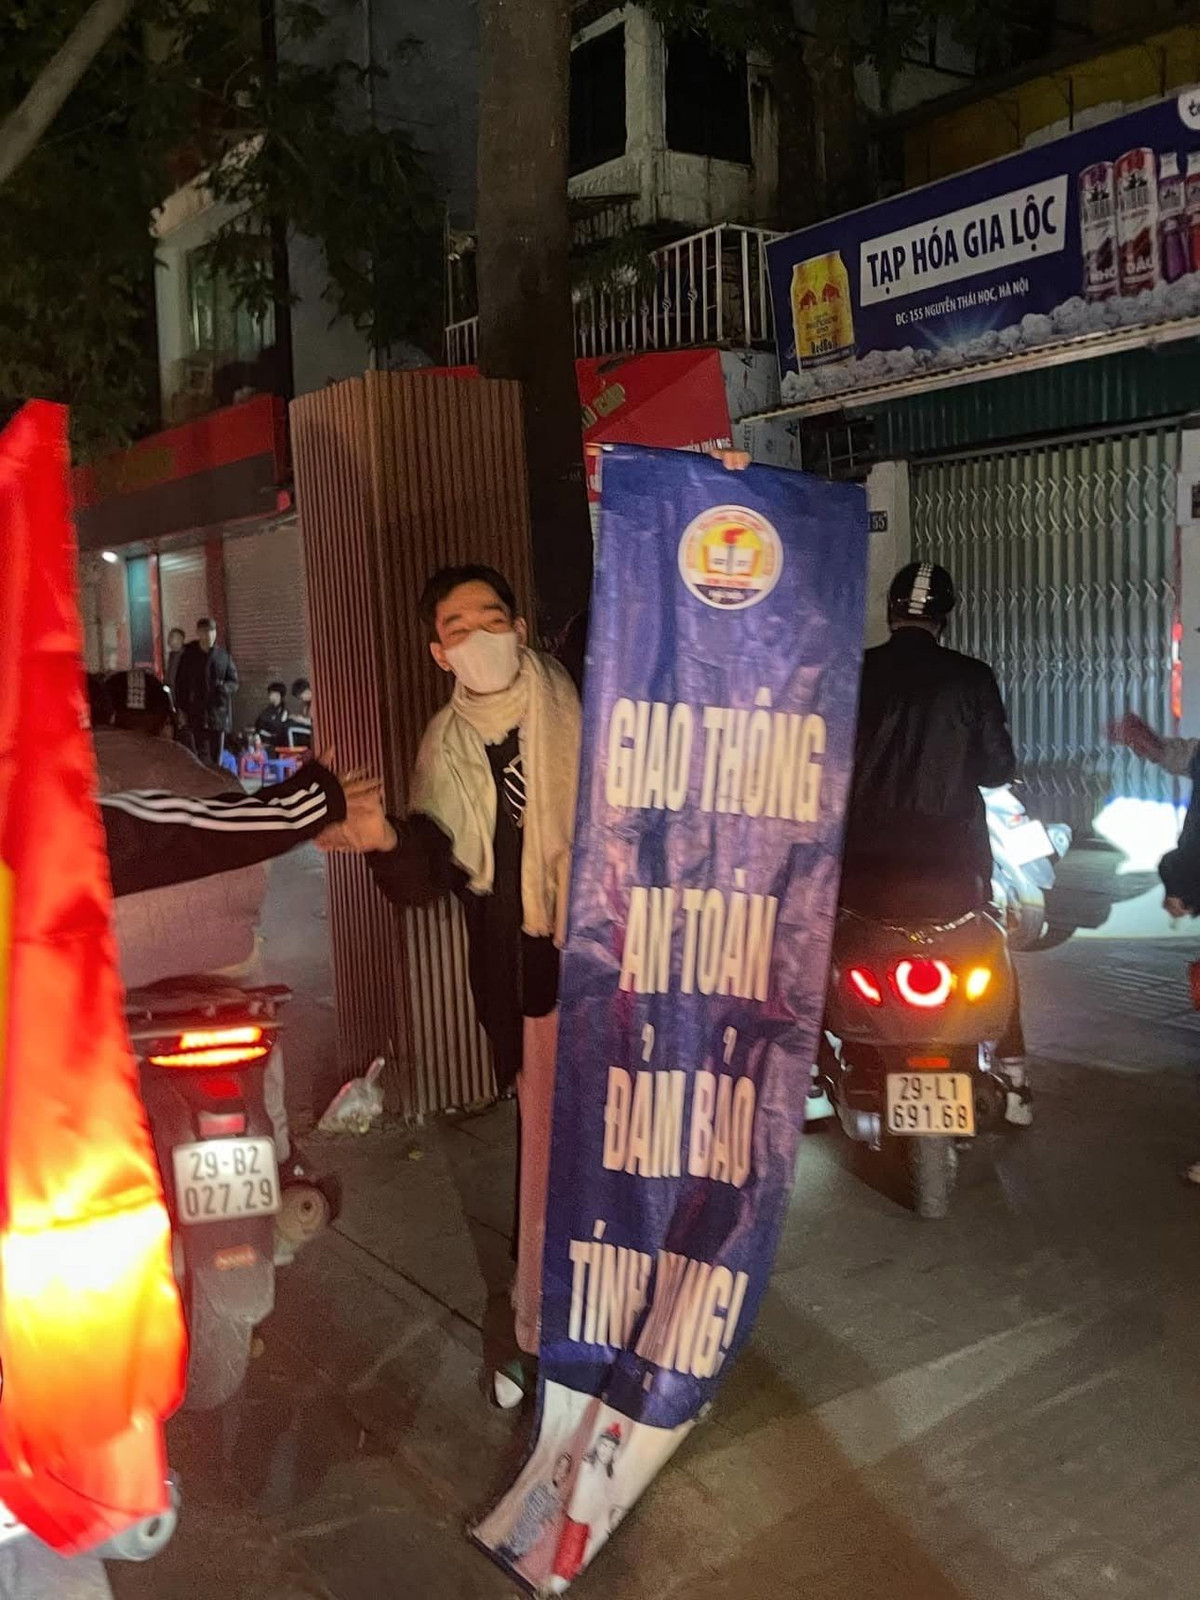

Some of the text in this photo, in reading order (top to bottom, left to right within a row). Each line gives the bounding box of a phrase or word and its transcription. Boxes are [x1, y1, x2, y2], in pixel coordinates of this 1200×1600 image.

[866, 246, 906, 295] TẠP
[911, 225, 960, 275] HÓA
[963, 214, 1005, 258] GIA
[1010, 194, 1057, 251] LỘC
[910, 307, 924, 322] 155
[956, 291, 977, 309] THÁI
[998, 282, 1012, 298] HÀ
[1012, 277, 1030, 296] NỘI
[605, 698, 693, 811] GIAO
[700, 687, 827, 822] THÔNG
[618, 867, 779, 1002] AN TOÀN
[602, 1023, 756, 1189] ĐẢM BẢO
[900, 1076, 957, 1101] 29-L1
[893, 1104, 968, 1129] 691.68
[190, 1145, 262, 1181] 29-B2
[184, 1178, 273, 1216] 027.29
